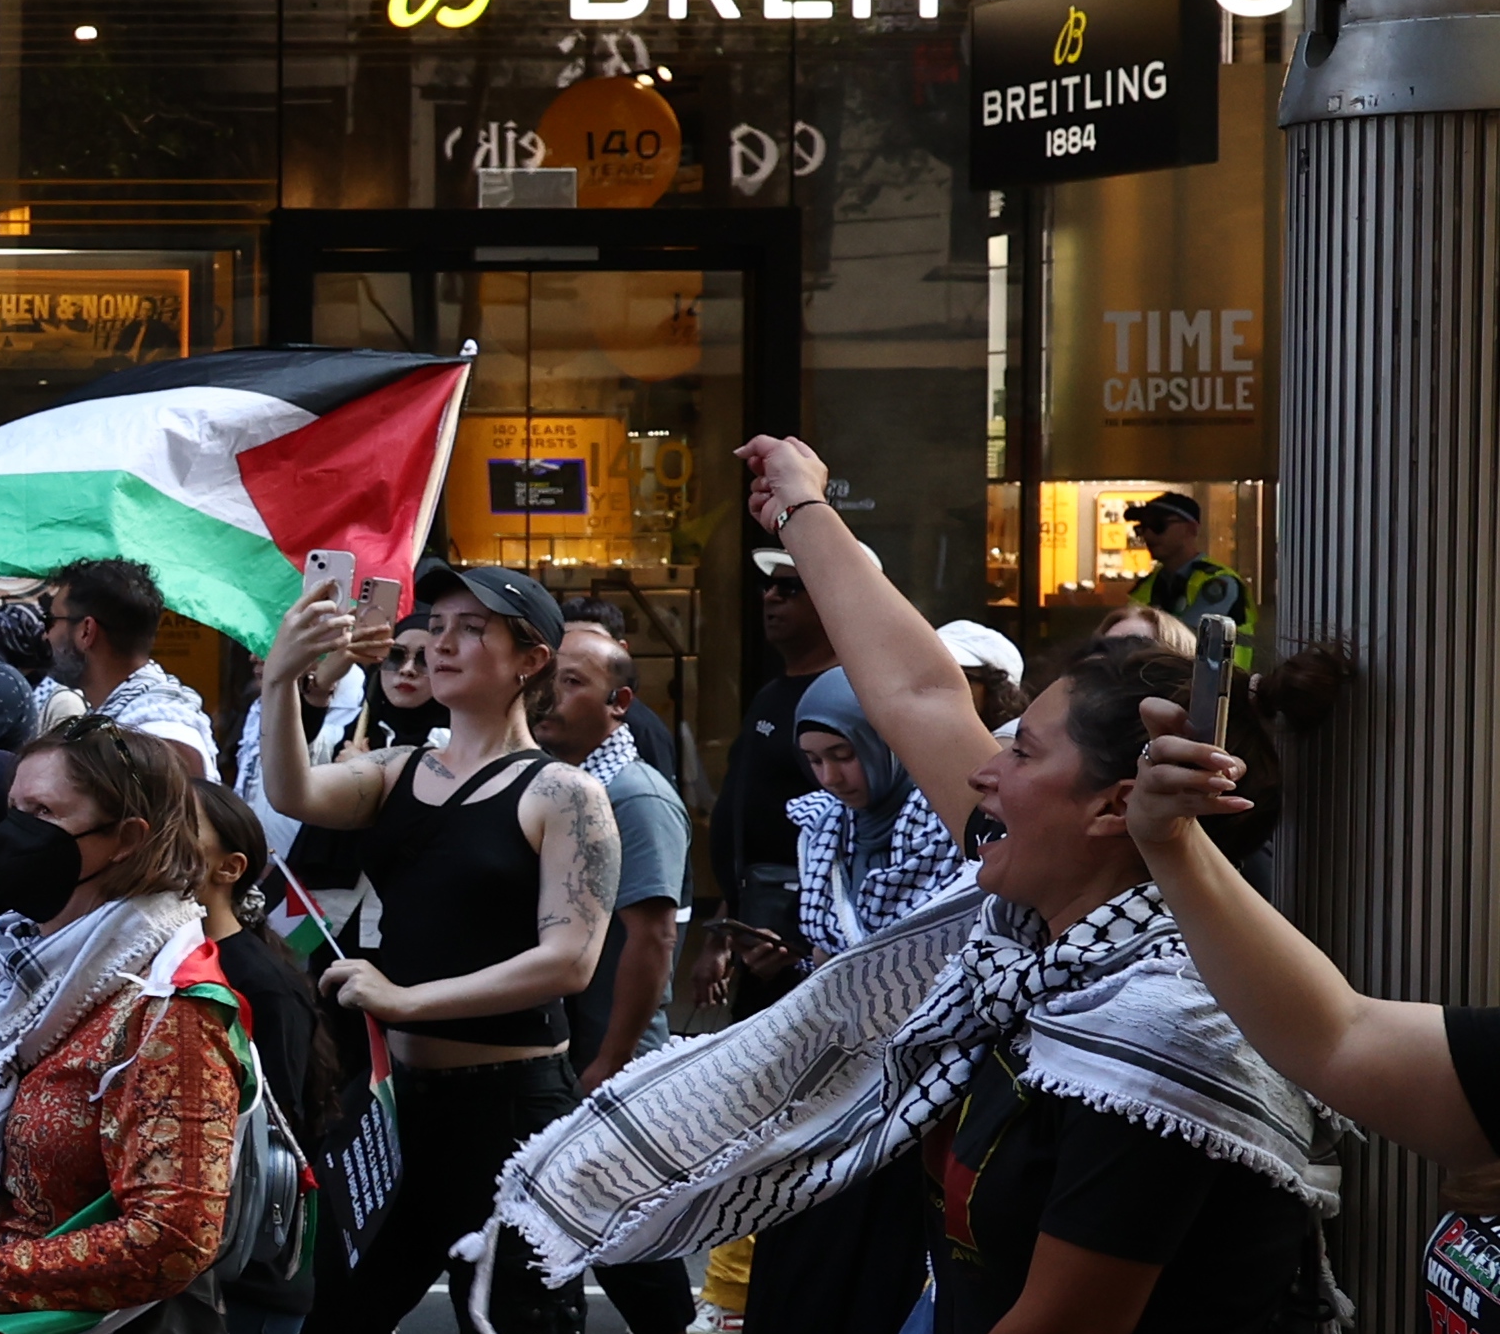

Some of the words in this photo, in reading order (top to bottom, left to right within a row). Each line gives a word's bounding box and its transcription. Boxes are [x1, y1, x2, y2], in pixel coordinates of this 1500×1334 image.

[982, 60, 1168, 127] BREITLING
[586, 129, 661, 160] 140
[1045, 123, 1097, 158] 1884
[1102, 308, 1254, 374] TIME
[1102, 375, 1255, 413] CAPSULE
[1426, 1256, 1461, 1301] WILL
[1461, 1284, 1482, 1320] BE
